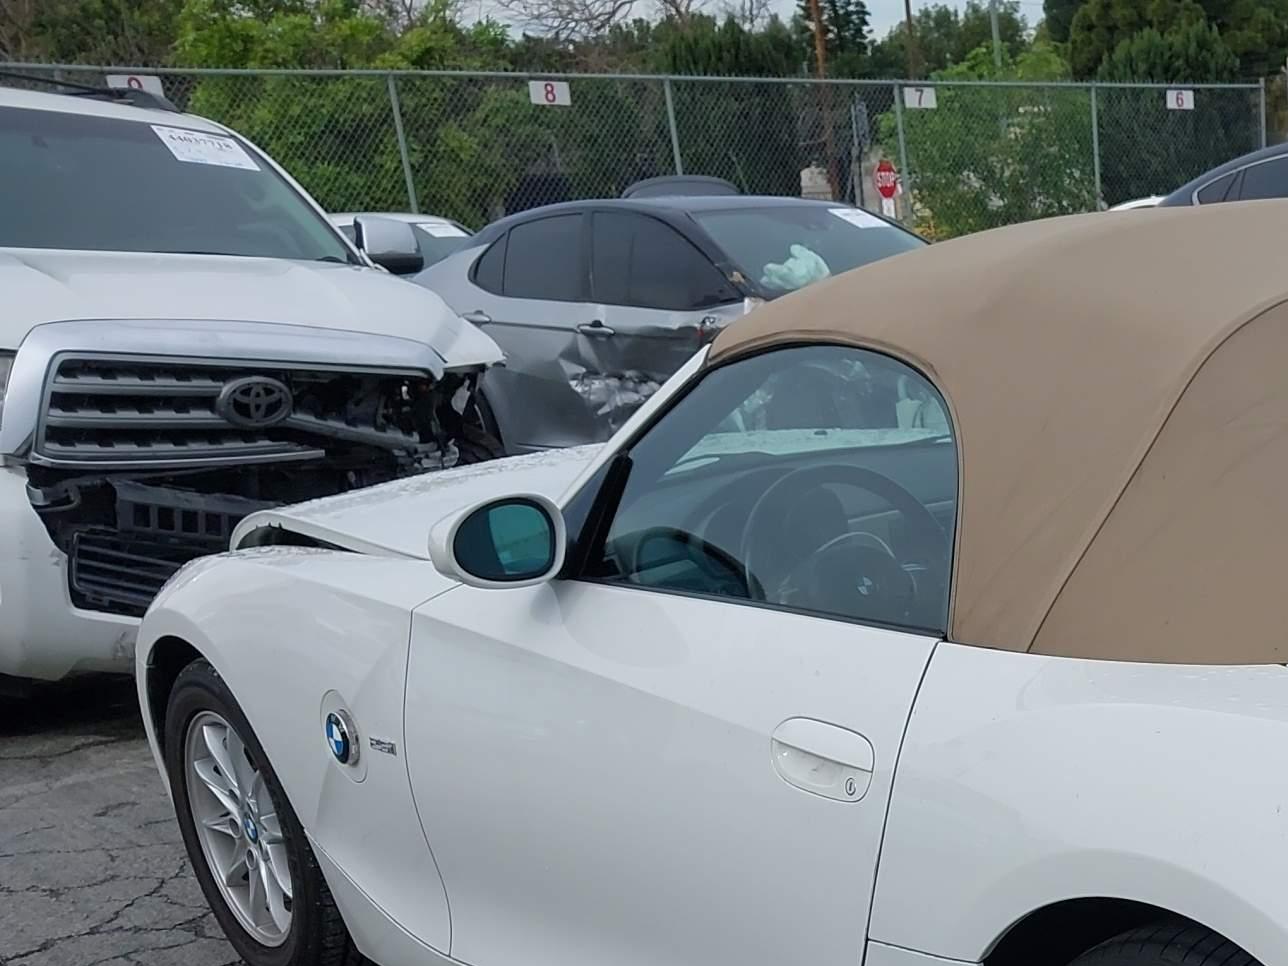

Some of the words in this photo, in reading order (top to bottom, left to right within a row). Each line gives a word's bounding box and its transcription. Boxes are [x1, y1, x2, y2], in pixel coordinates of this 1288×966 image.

[544, 82, 556, 103] 8
[915, 88, 924, 107] 7
[1176, 91, 1184, 107] 6
[876, 171, 896, 188] STOP
